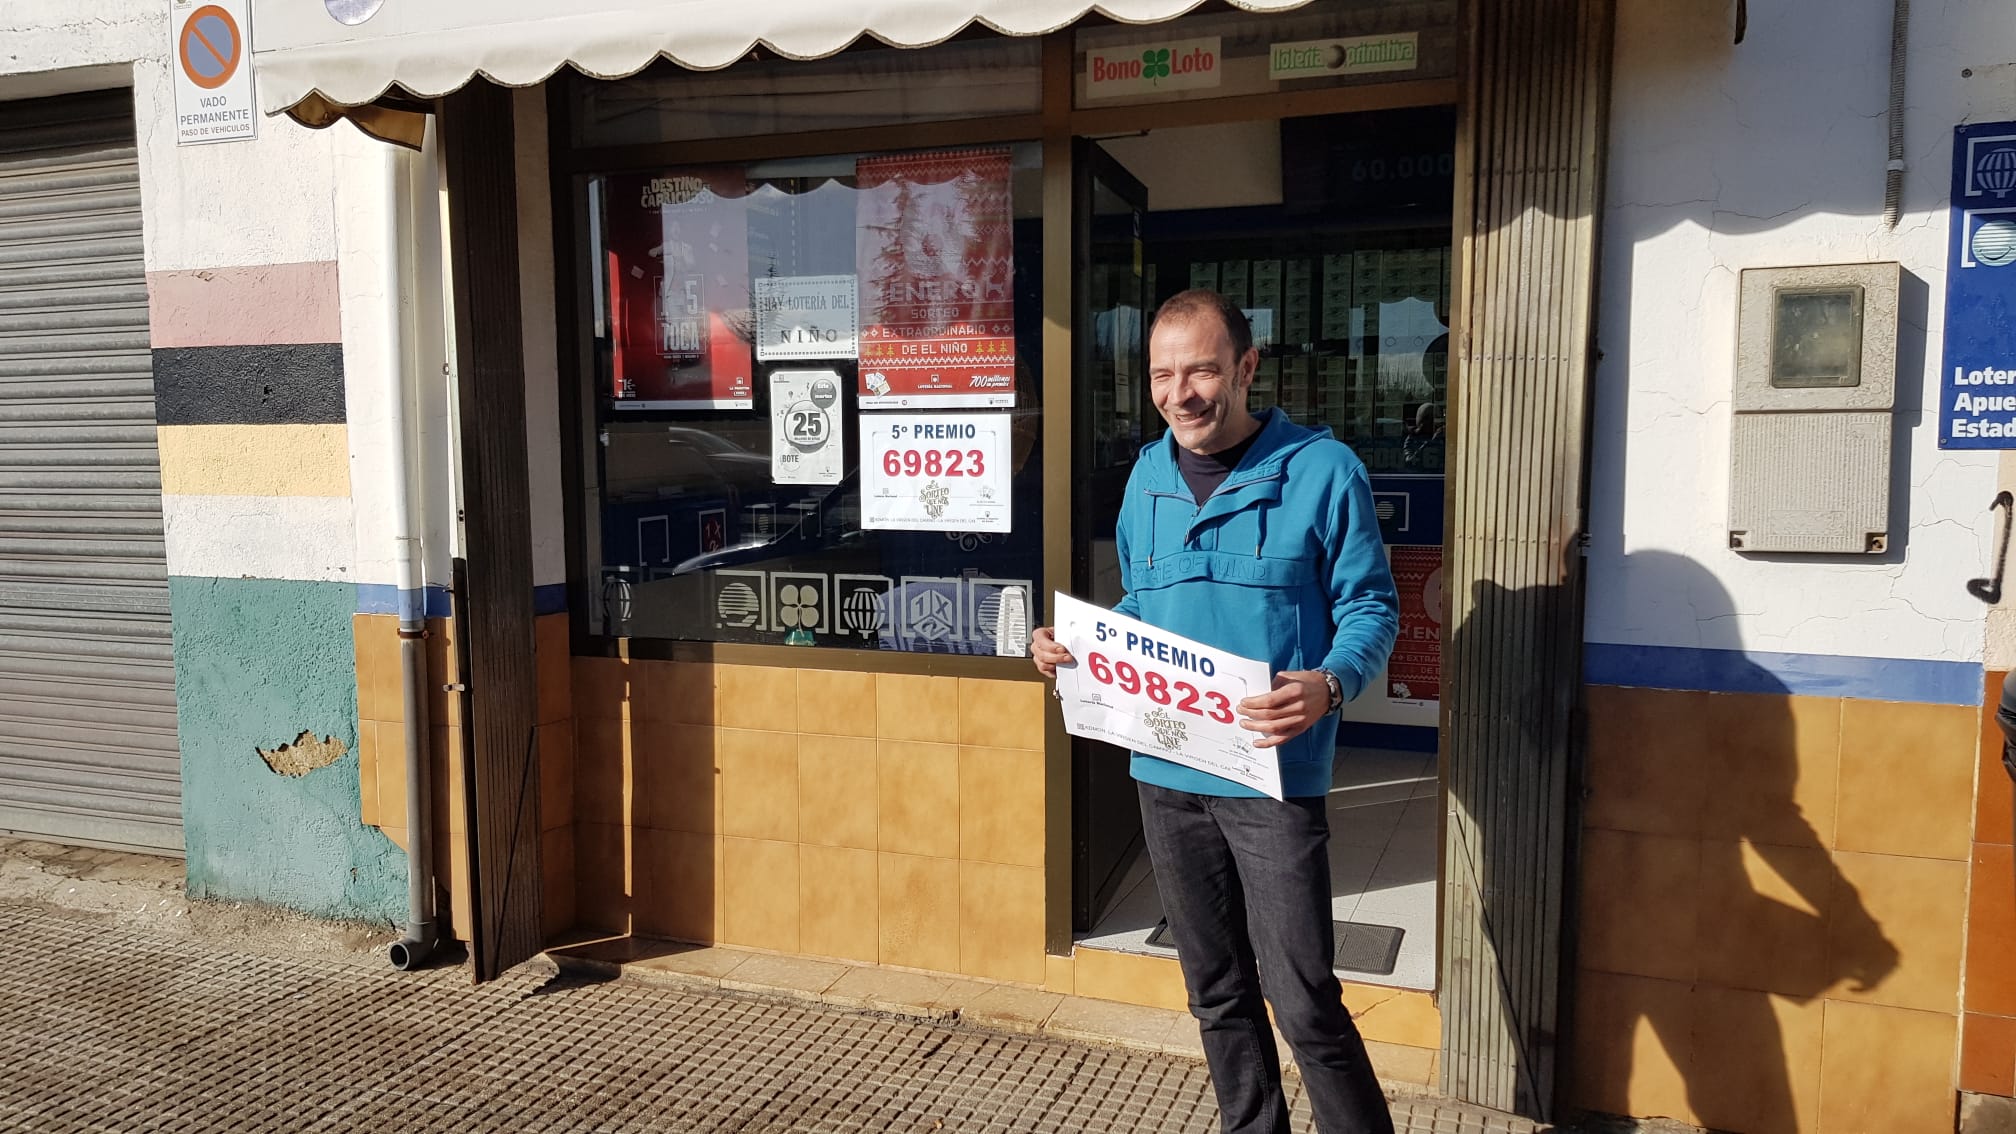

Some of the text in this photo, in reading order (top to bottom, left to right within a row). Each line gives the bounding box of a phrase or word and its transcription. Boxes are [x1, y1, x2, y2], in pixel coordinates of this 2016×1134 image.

[1093, 47, 1214, 82] Bono Loto
[200, 95, 227, 108] VADO
[180, 109, 249, 125] PERMANENTE
[181, 128, 198, 137] PASO
[200, 127, 209, 135] DE
[650, 176, 703, 195] DESTINO
[889, 280, 980, 302] ENERO
[788, 291, 826, 310] LOTERÍA
[832, 295, 849, 309] DEL
[911, 307, 960, 319] SORTEO
[781, 325, 838, 343] NIÑO
[882, 324, 986, 338] EXTRAORDINARIO
[902, 342, 968, 355] DE EL NIÑO
[969, 375, 988, 388] 700
[1953, 392, 2016, 416] Apue
[793, 413, 821, 437] 25
[914, 424, 976, 440] PREMIO
[1951, 417, 2016, 438] Estad
[782, 454, 799, 463] BOTE
[883, 449, 985, 477] 69823
[1179, 556, 1206, 574] OF
[1213, 555, 1266, 581] MIND
[1413, 626, 1440, 641] EN
[1126, 631, 1215, 677] PREMIO
[1421, 666, 1433, 674] DE
[1088, 652, 1235, 724] 69823
[1144, 712, 1186, 730] SORTEO
